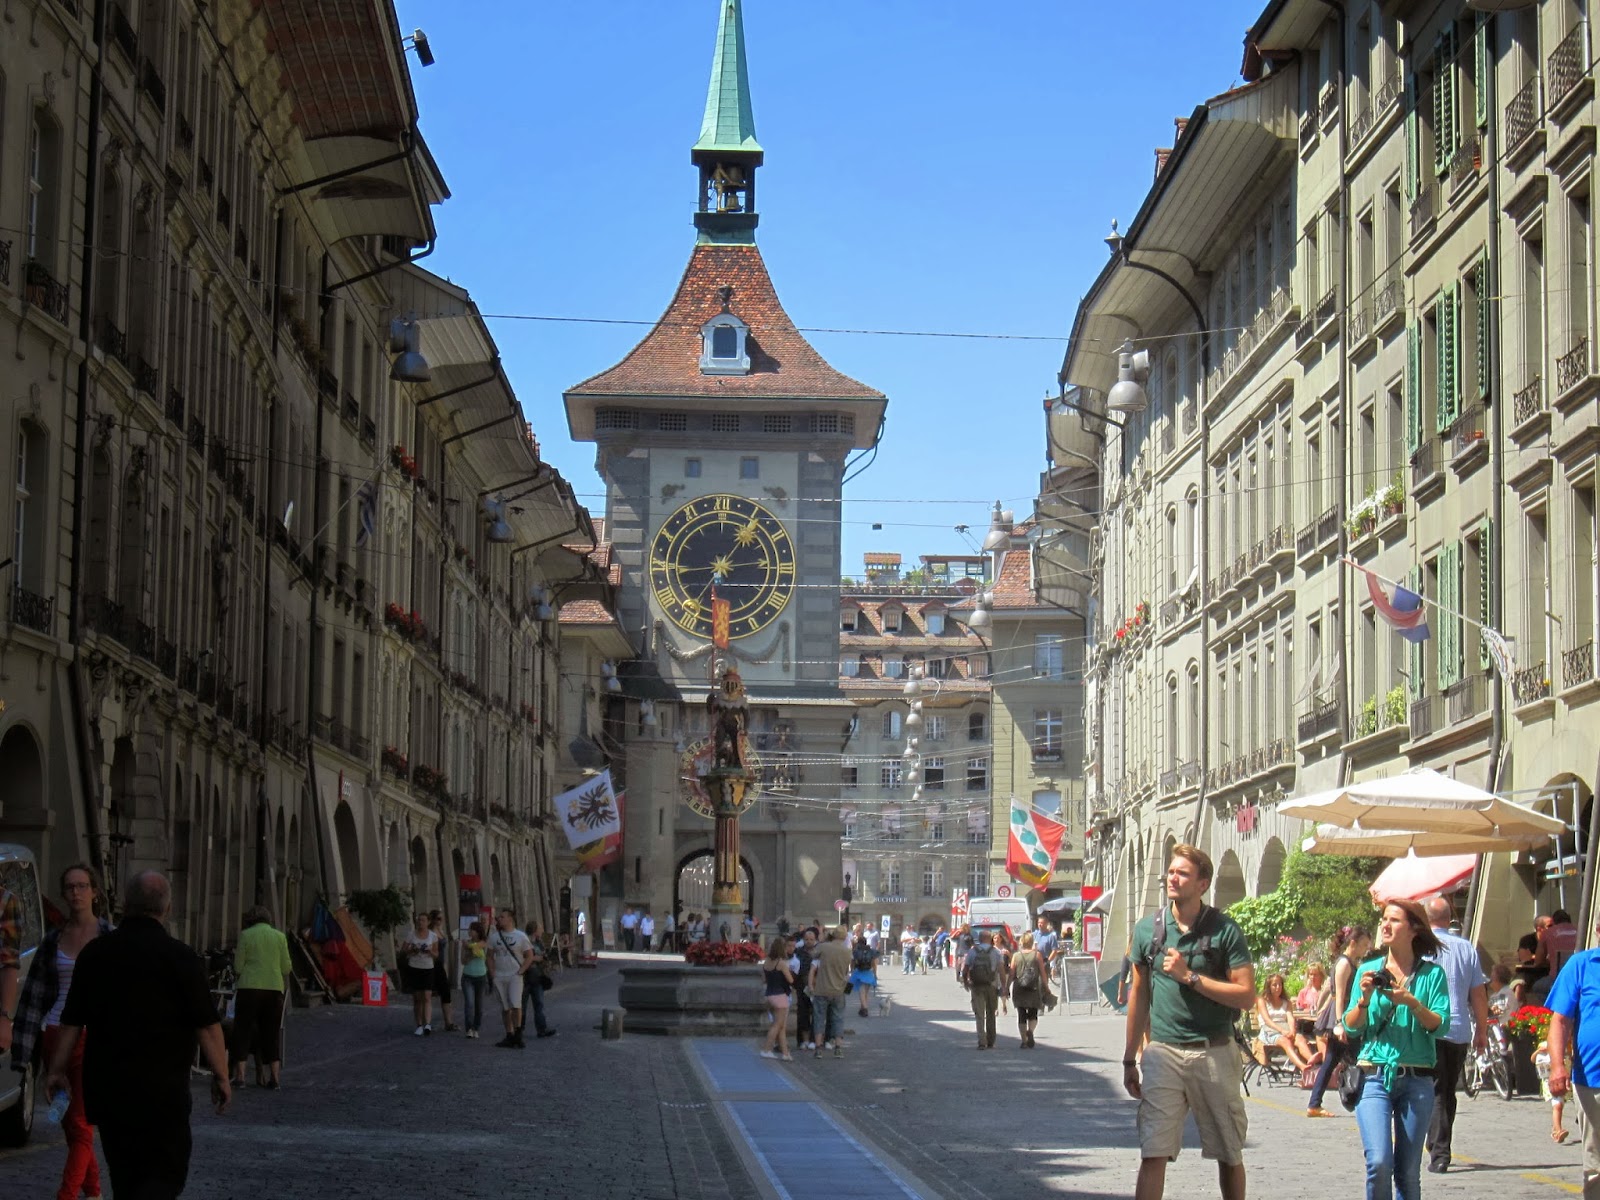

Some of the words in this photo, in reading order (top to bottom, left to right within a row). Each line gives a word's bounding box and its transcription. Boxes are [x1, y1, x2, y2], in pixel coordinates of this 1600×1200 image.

[714, 497, 730, 510] XII
[684, 505, 698, 521] XI
[751, 507, 758, 518] I
[662, 528, 673, 542] X
[772, 530, 785, 542] II
[652, 557, 666, 572] IX
[780, 562, 793, 574] III
[768, 592, 786, 610] IIII
[748, 617, 759, 630] V
